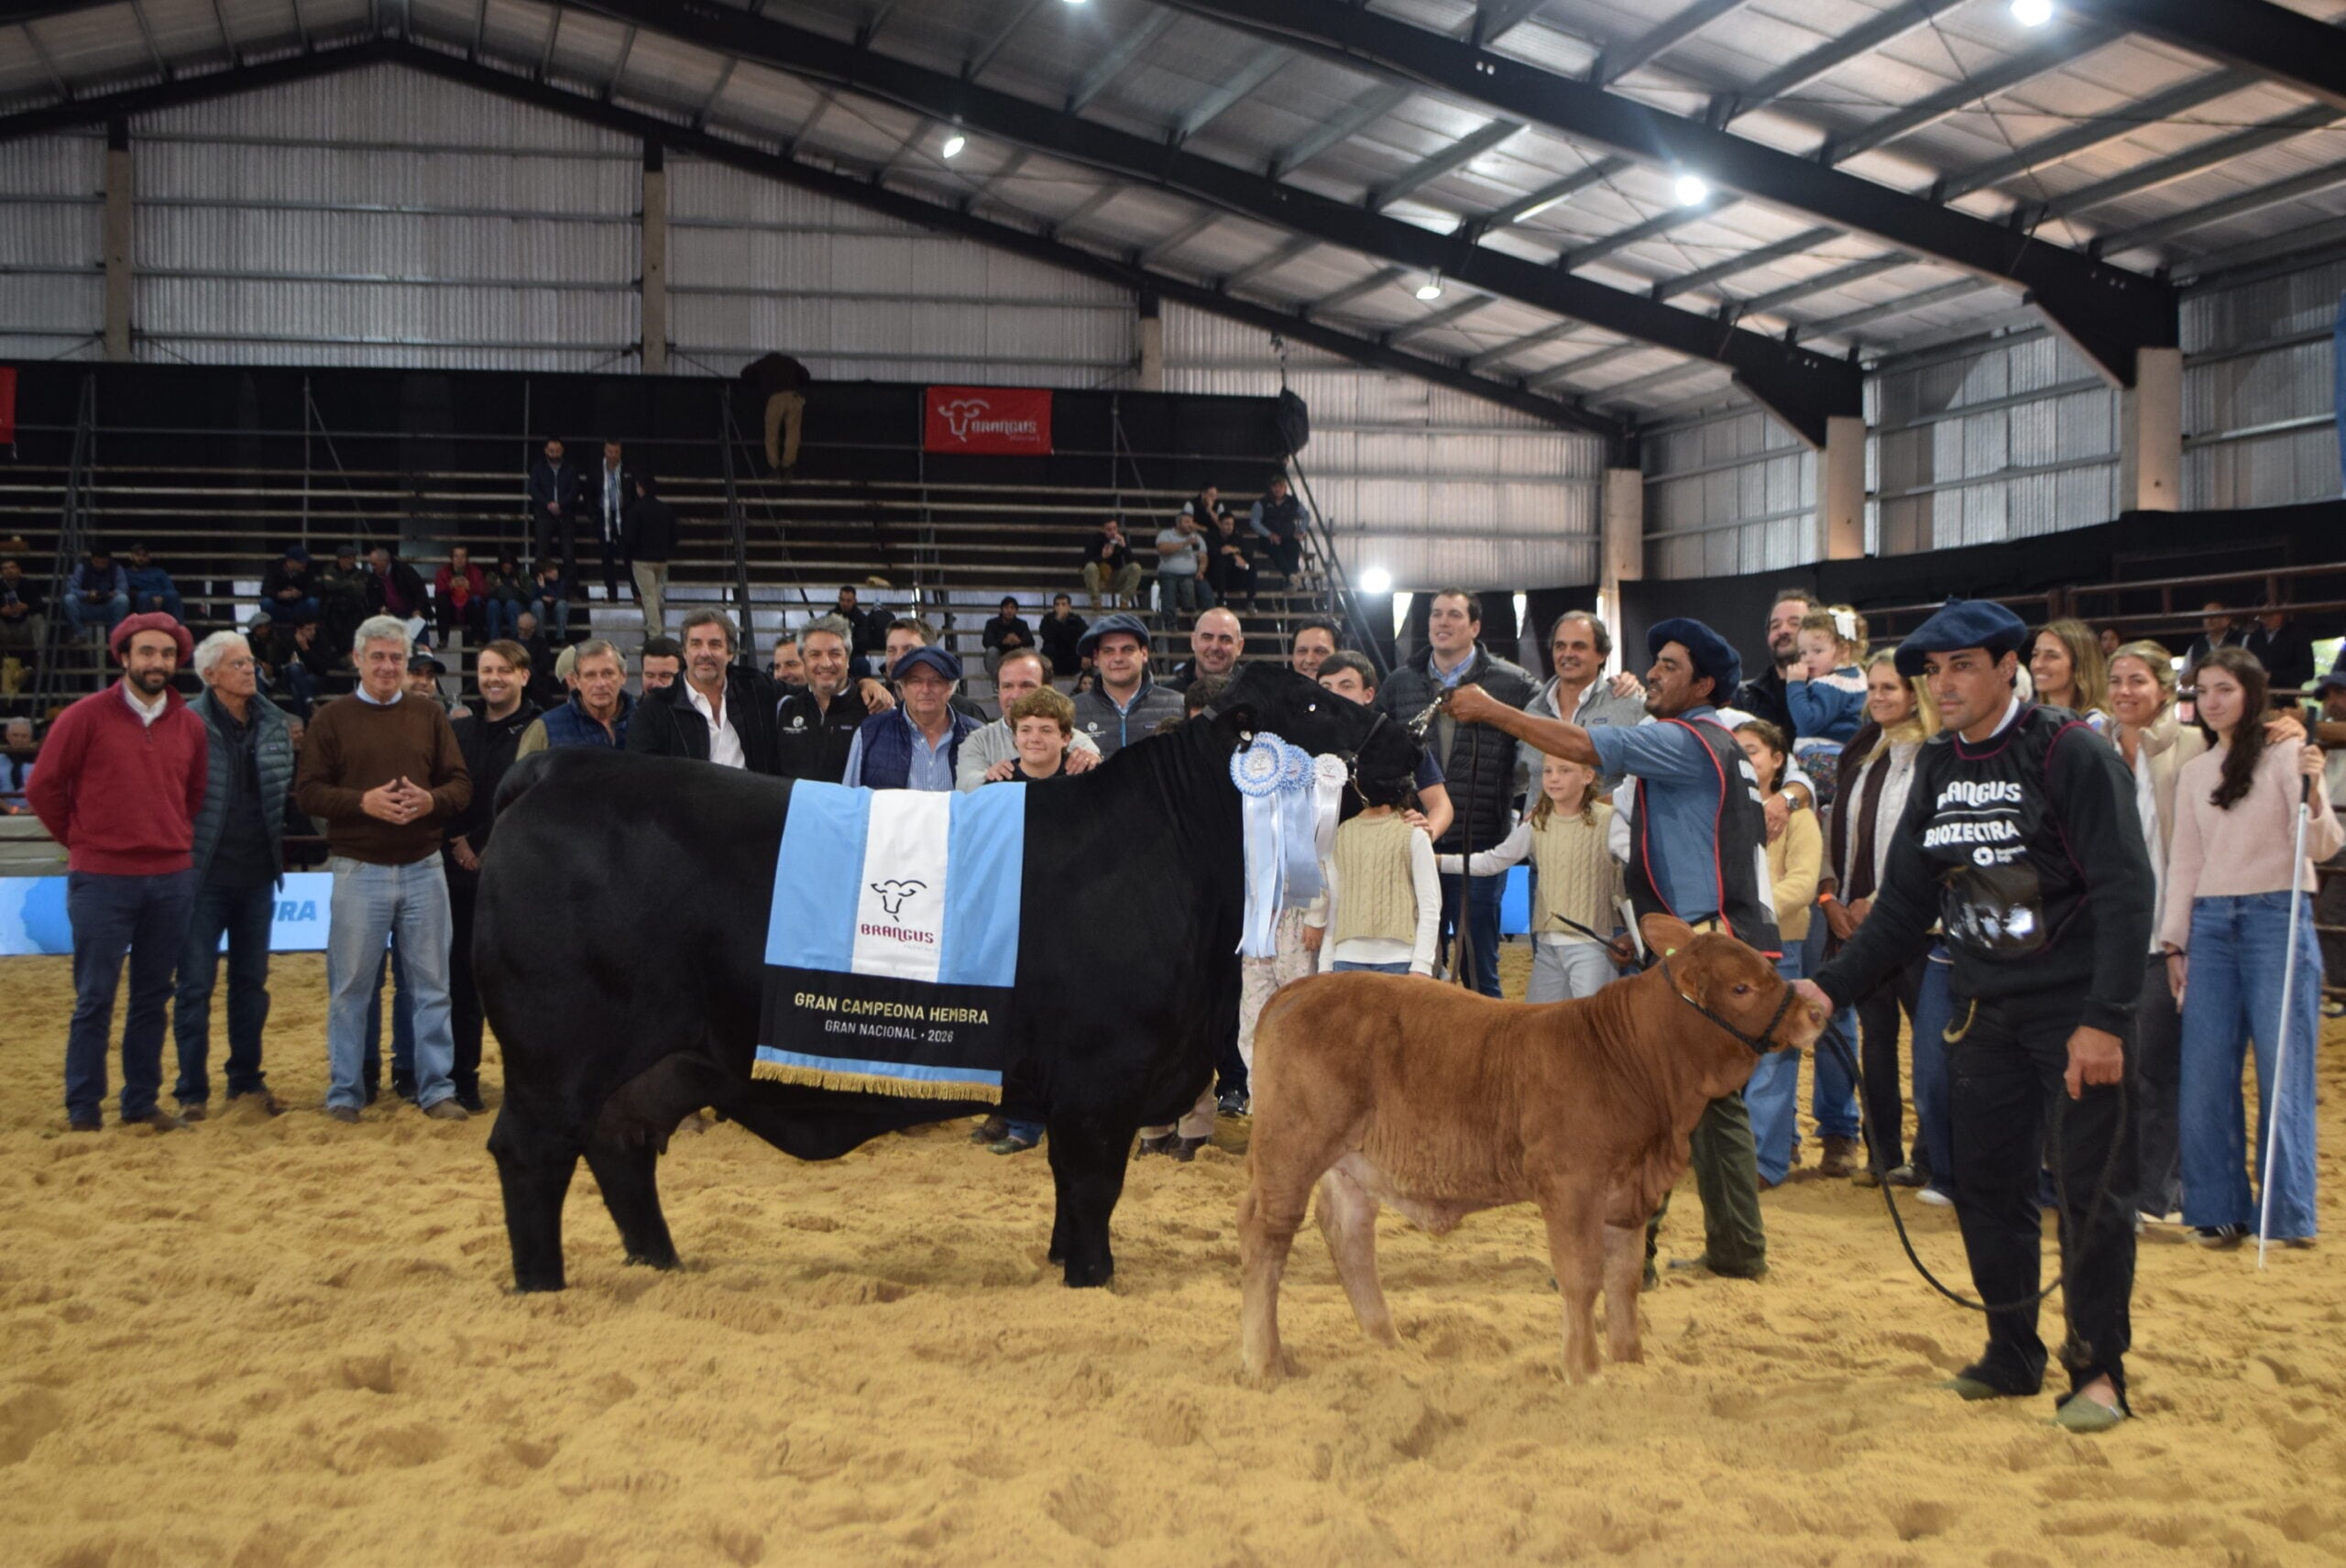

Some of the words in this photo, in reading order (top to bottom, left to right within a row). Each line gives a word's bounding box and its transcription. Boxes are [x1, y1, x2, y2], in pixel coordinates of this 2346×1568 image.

[971, 421, 1037, 435] BRANGUS
[1923, 820, 2022, 847] BIOZECTRA
[861, 924, 934, 944] BRANGUS
[795, 992, 838, 1013] GRAN
[841, 998, 925, 1020] CAMPEONA
[929, 1006, 989, 1025] HEMBRA
[825, 1019, 856, 1034] GRAN
[859, 1024, 917, 1040] NACIONAL
[927, 1029, 954, 1043] 2026
